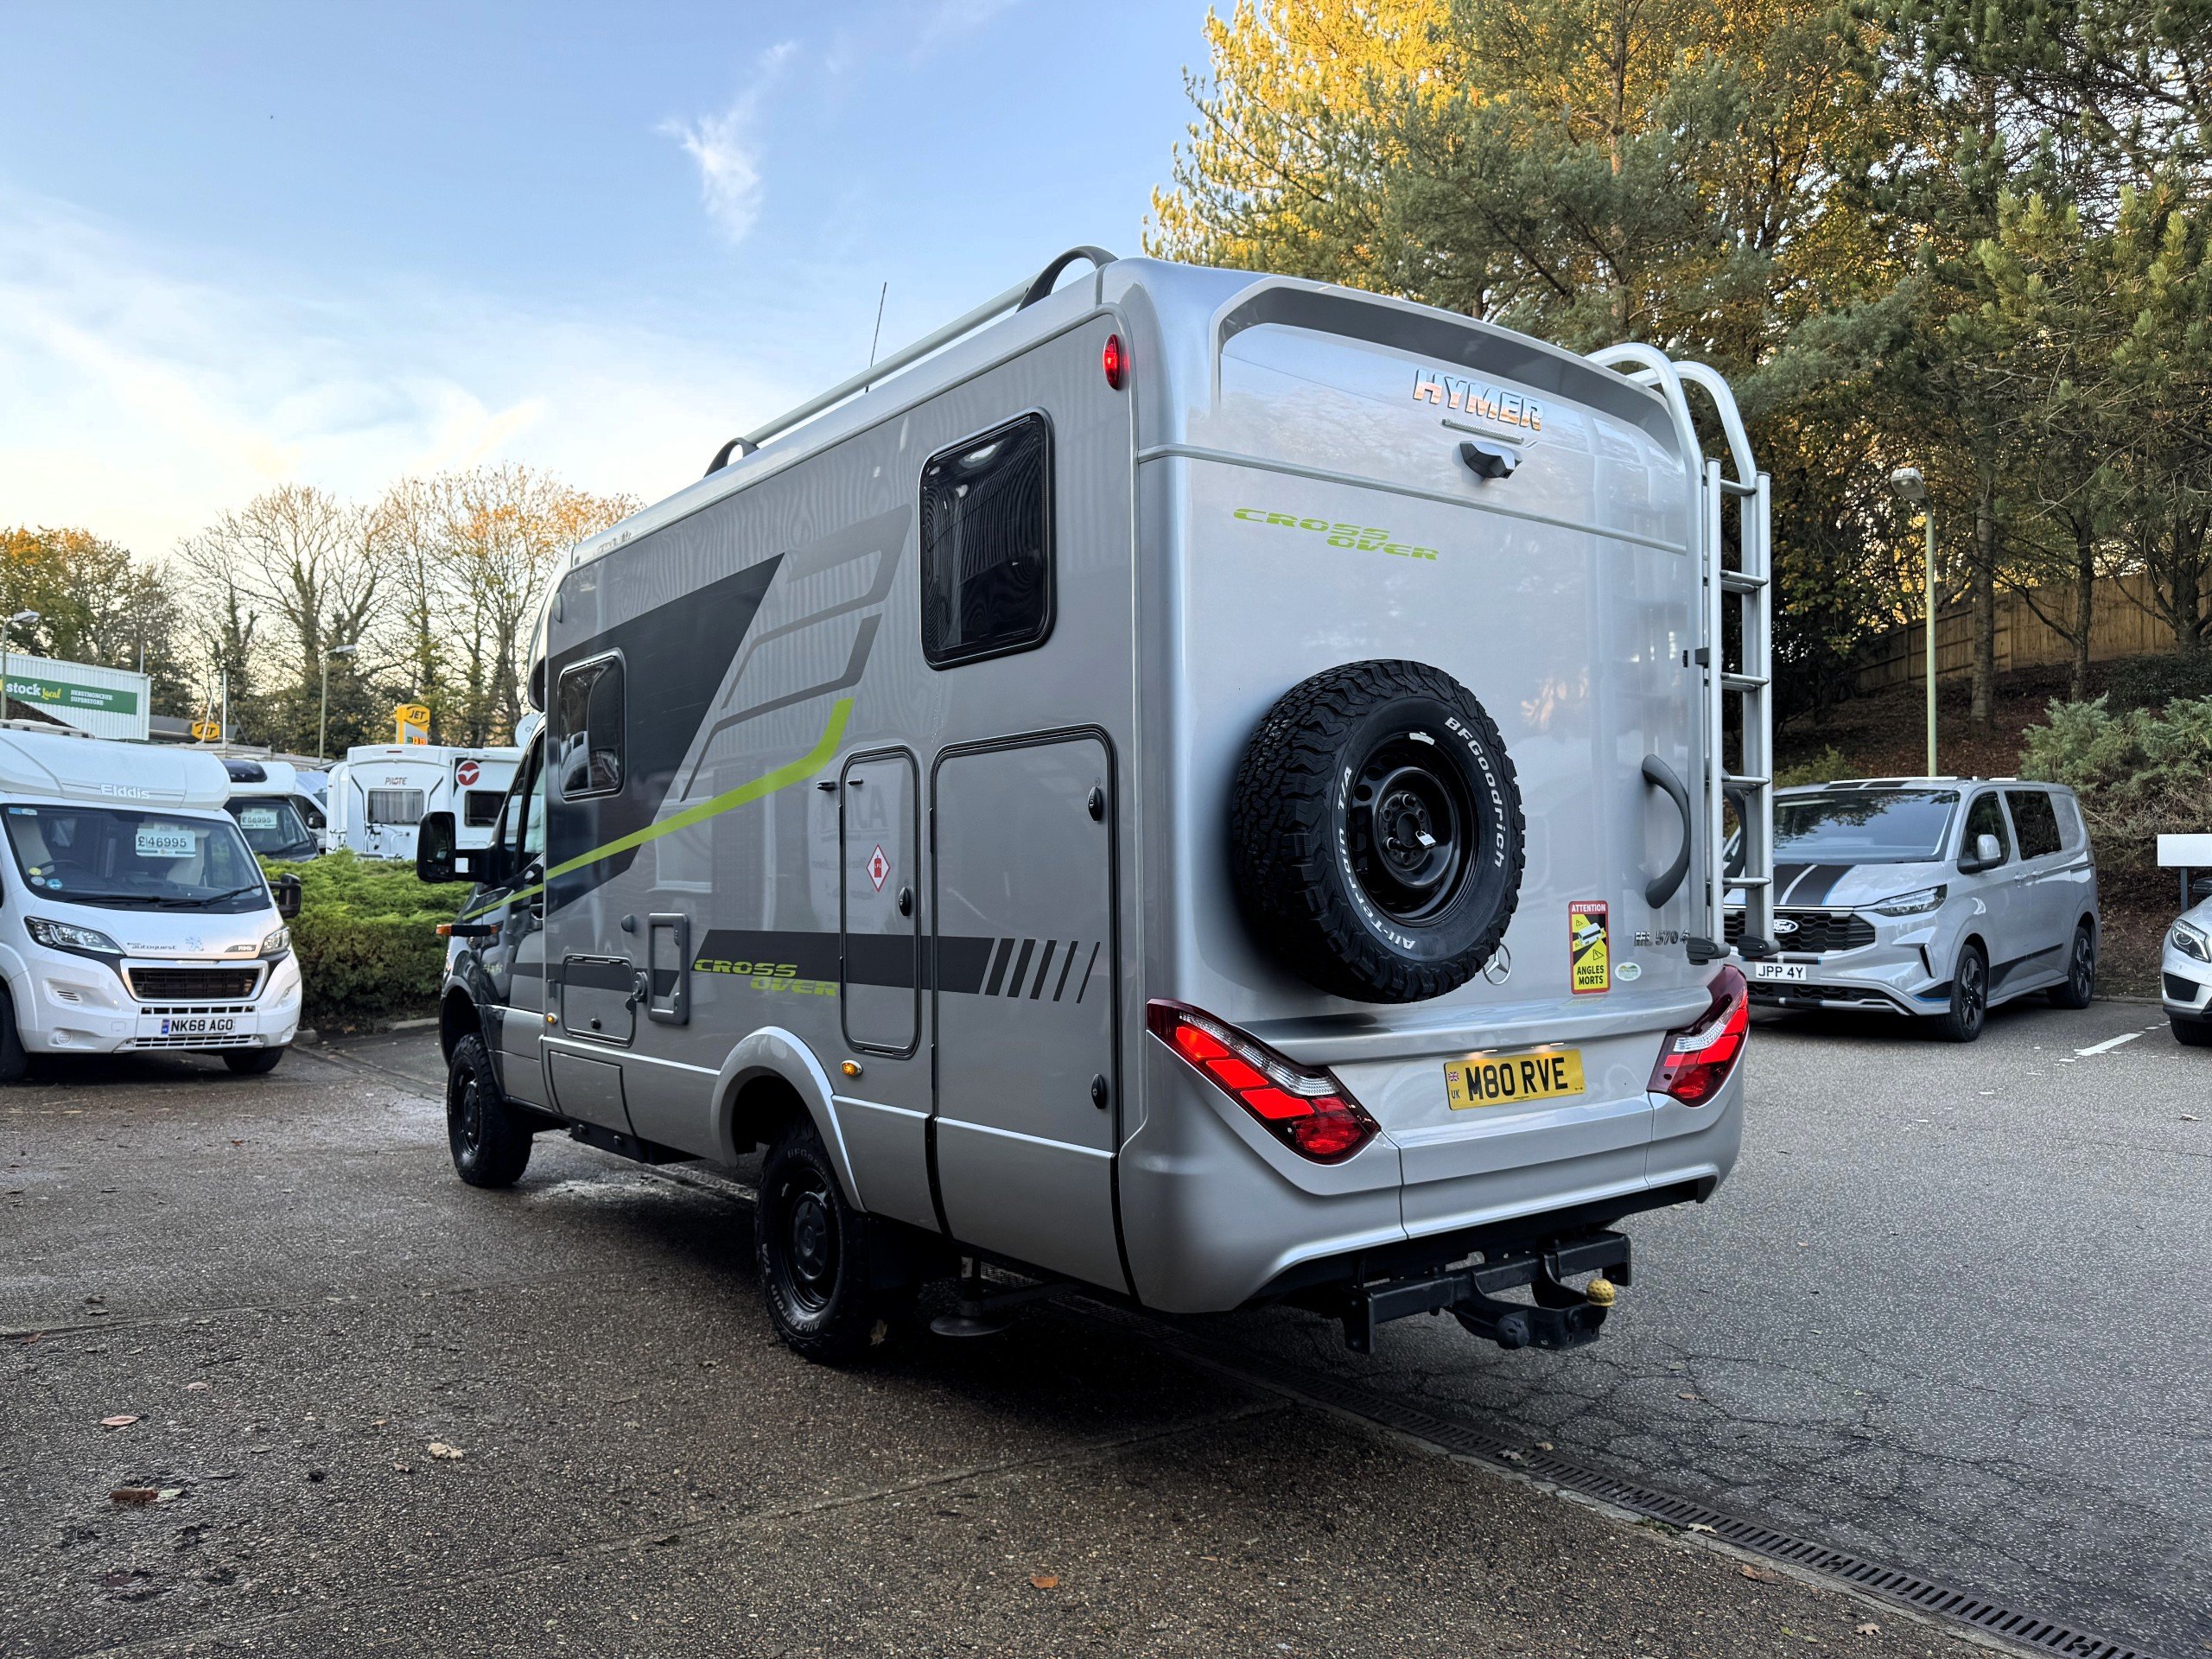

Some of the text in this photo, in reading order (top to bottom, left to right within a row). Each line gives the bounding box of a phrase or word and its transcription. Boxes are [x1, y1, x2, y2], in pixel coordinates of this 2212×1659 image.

[1413, 369, 1545, 432] HYMER
[1233, 508, 1389, 541] CROSS
[1326, 535, 1440, 561] OVER
[5, 682, 41, 696] stock
[409, 709, 426, 721] JET
[197, 725, 216, 736] JT
[384, 776, 408, 786] PILOTE
[1337, 766, 1352, 810] T/A
[100, 783, 150, 799] Elddis
[1444, 716, 1507, 868] BFGoodrich
[137, 836, 187, 848] £46995
[1572, 904, 1606, 912] ATTENTION
[1656, 930, 1679, 946] 570
[694, 958, 798, 978] CROSS
[1577, 964, 1605, 976] ANGLES
[1758, 965, 1803, 978] JPP 4Y
[750, 976, 840, 997] OVER
[1579, 975, 1604, 986] MORTS
[171, 1020, 206, 1032] NK68
[209, 1019, 233, 1032] AGO
[1465, 1057, 1569, 1102] M80 RVE
[1451, 1089, 1460, 1100] UK
